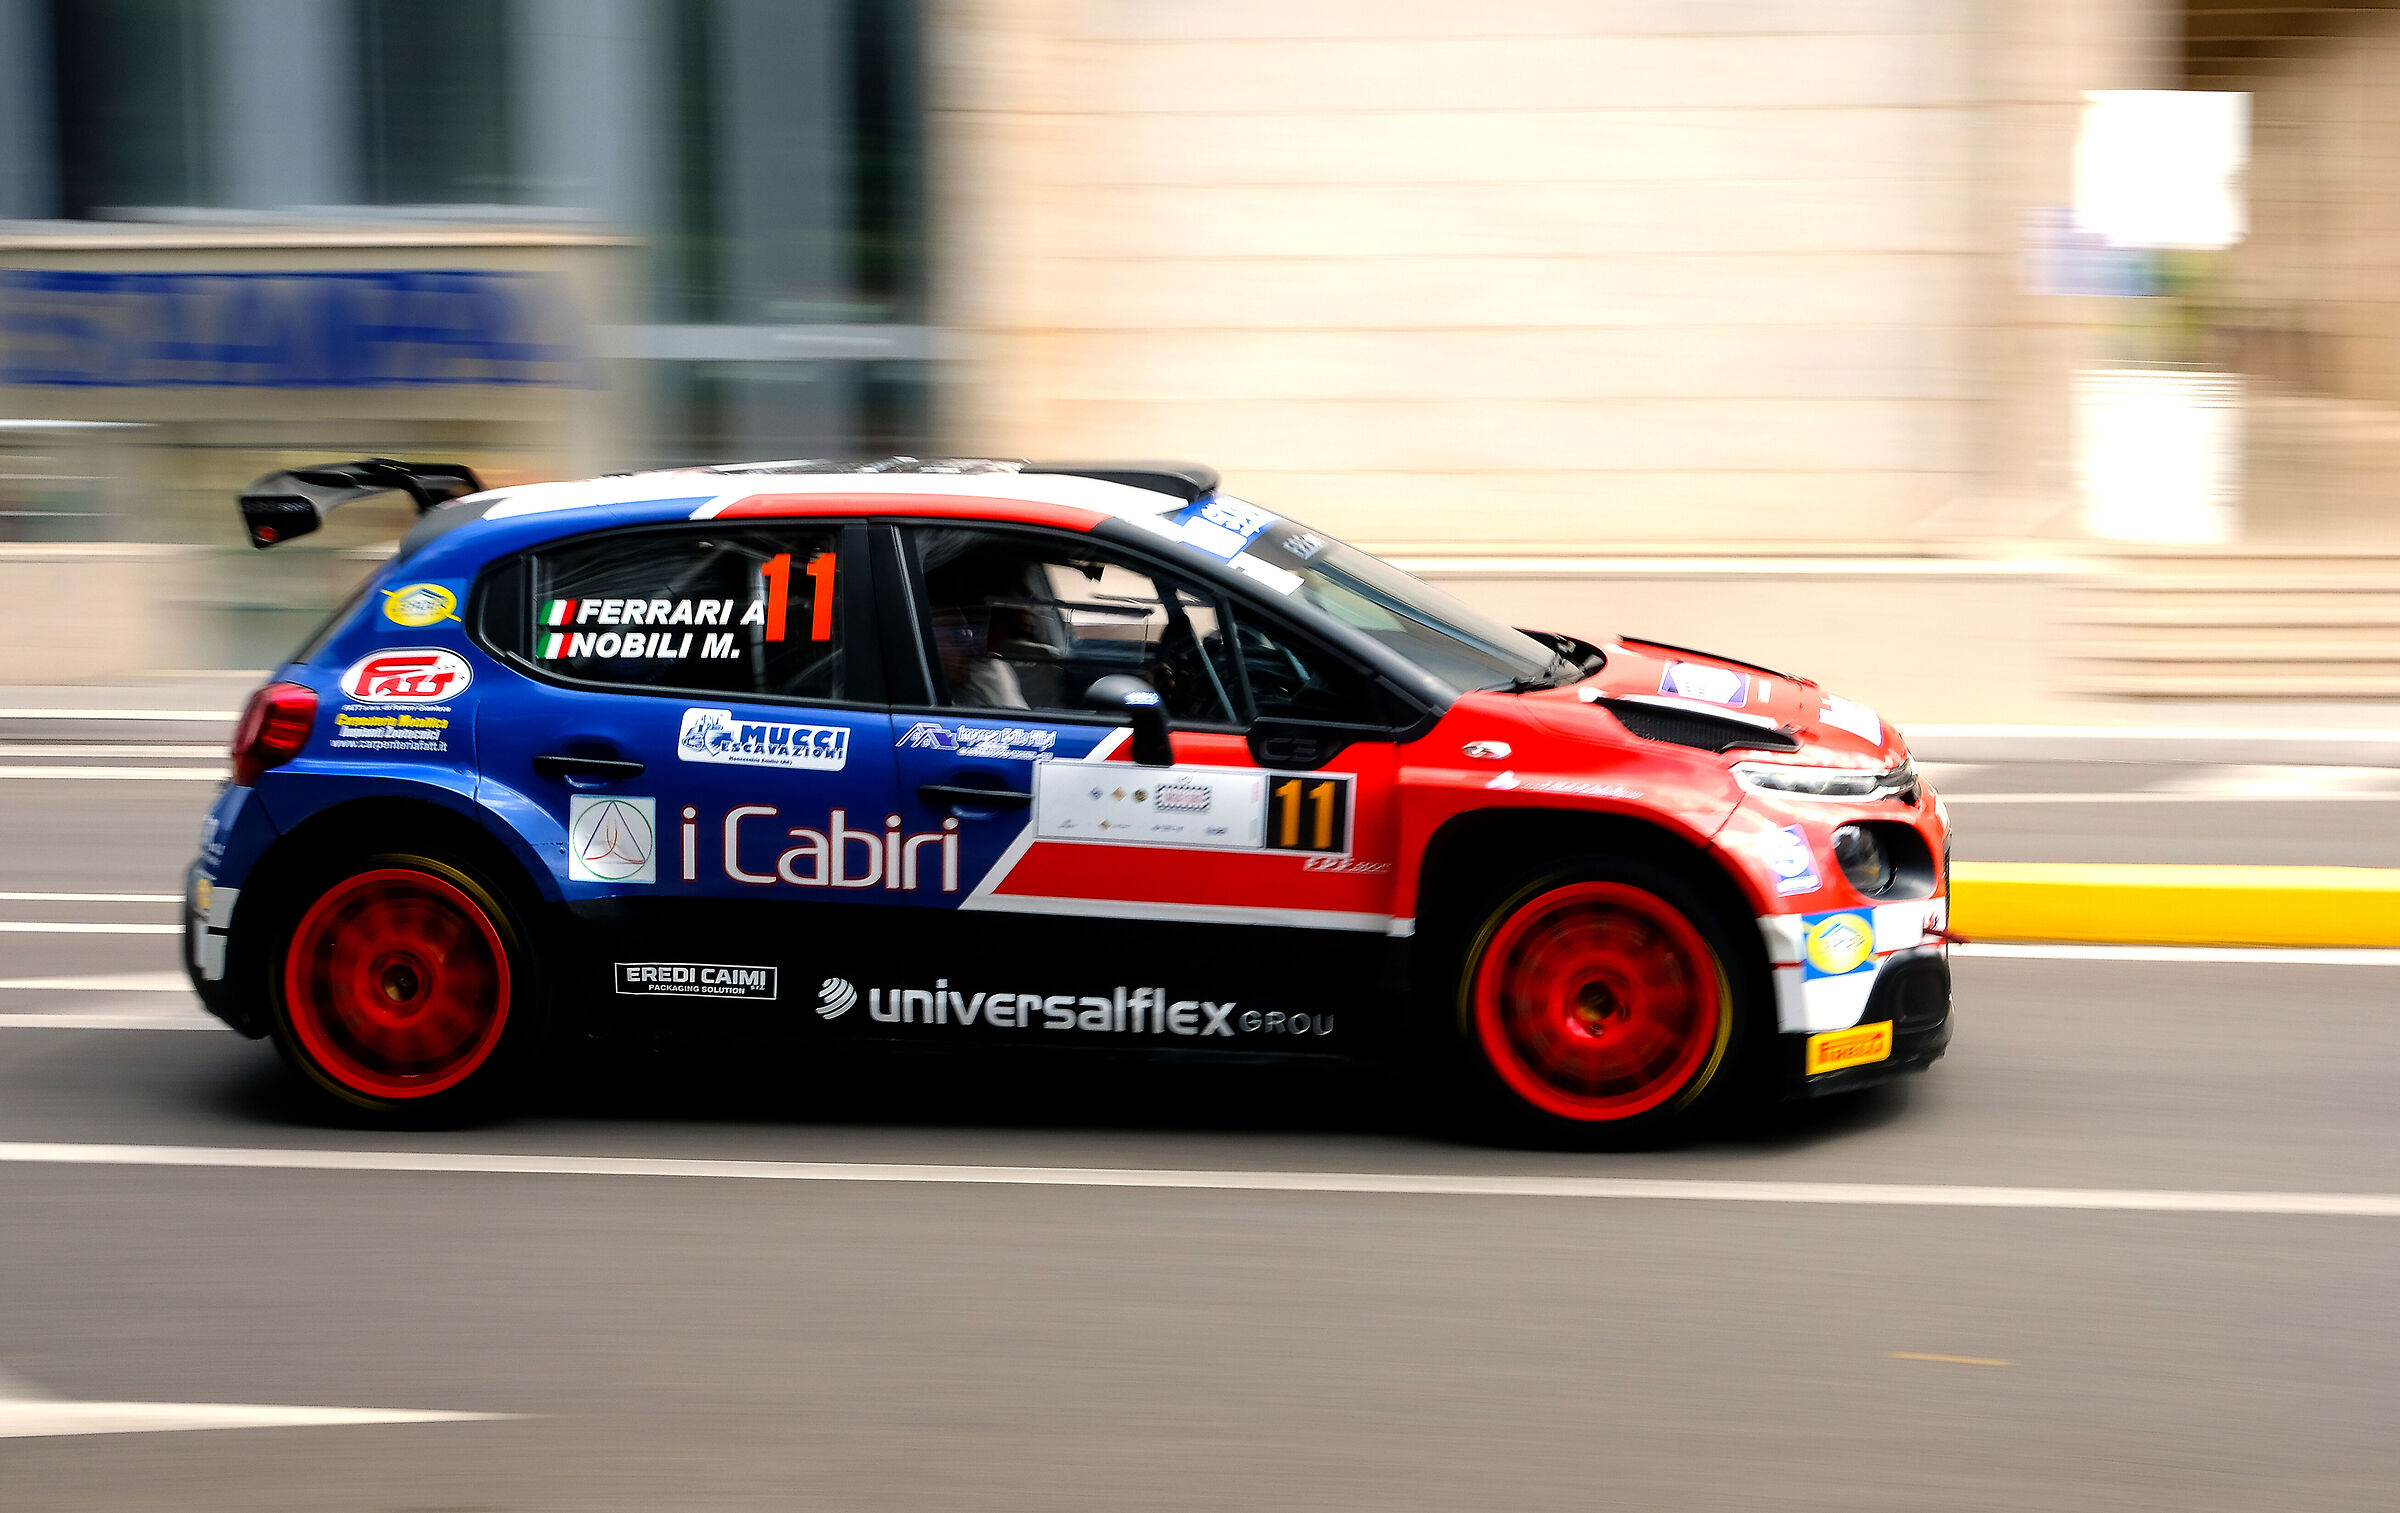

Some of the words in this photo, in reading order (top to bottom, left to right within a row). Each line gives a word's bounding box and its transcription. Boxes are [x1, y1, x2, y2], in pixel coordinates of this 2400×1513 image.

[761, 552, 837, 642] 11
[576, 599, 734, 626] FERRARI
[568, 632, 693, 659] NOBILI
[700, 633, 741, 659] M.
[739, 724, 847, 748] MUCCI
[720, 740, 844, 760] ESCAVAZIONI
[1275, 778, 1336, 849] 11
[680, 806, 698, 882] i
[722, 803, 960, 893] Cabiri
[626, 967, 696, 983] EREDI
[700, 968, 766, 986] CAIMI
[648, 984, 700, 993] PACKAGING
[701, 985, 746, 995] SOLUTION
[869, 978, 1237, 1037] universalflex
[1238, 1009, 1335, 1037] GROU
